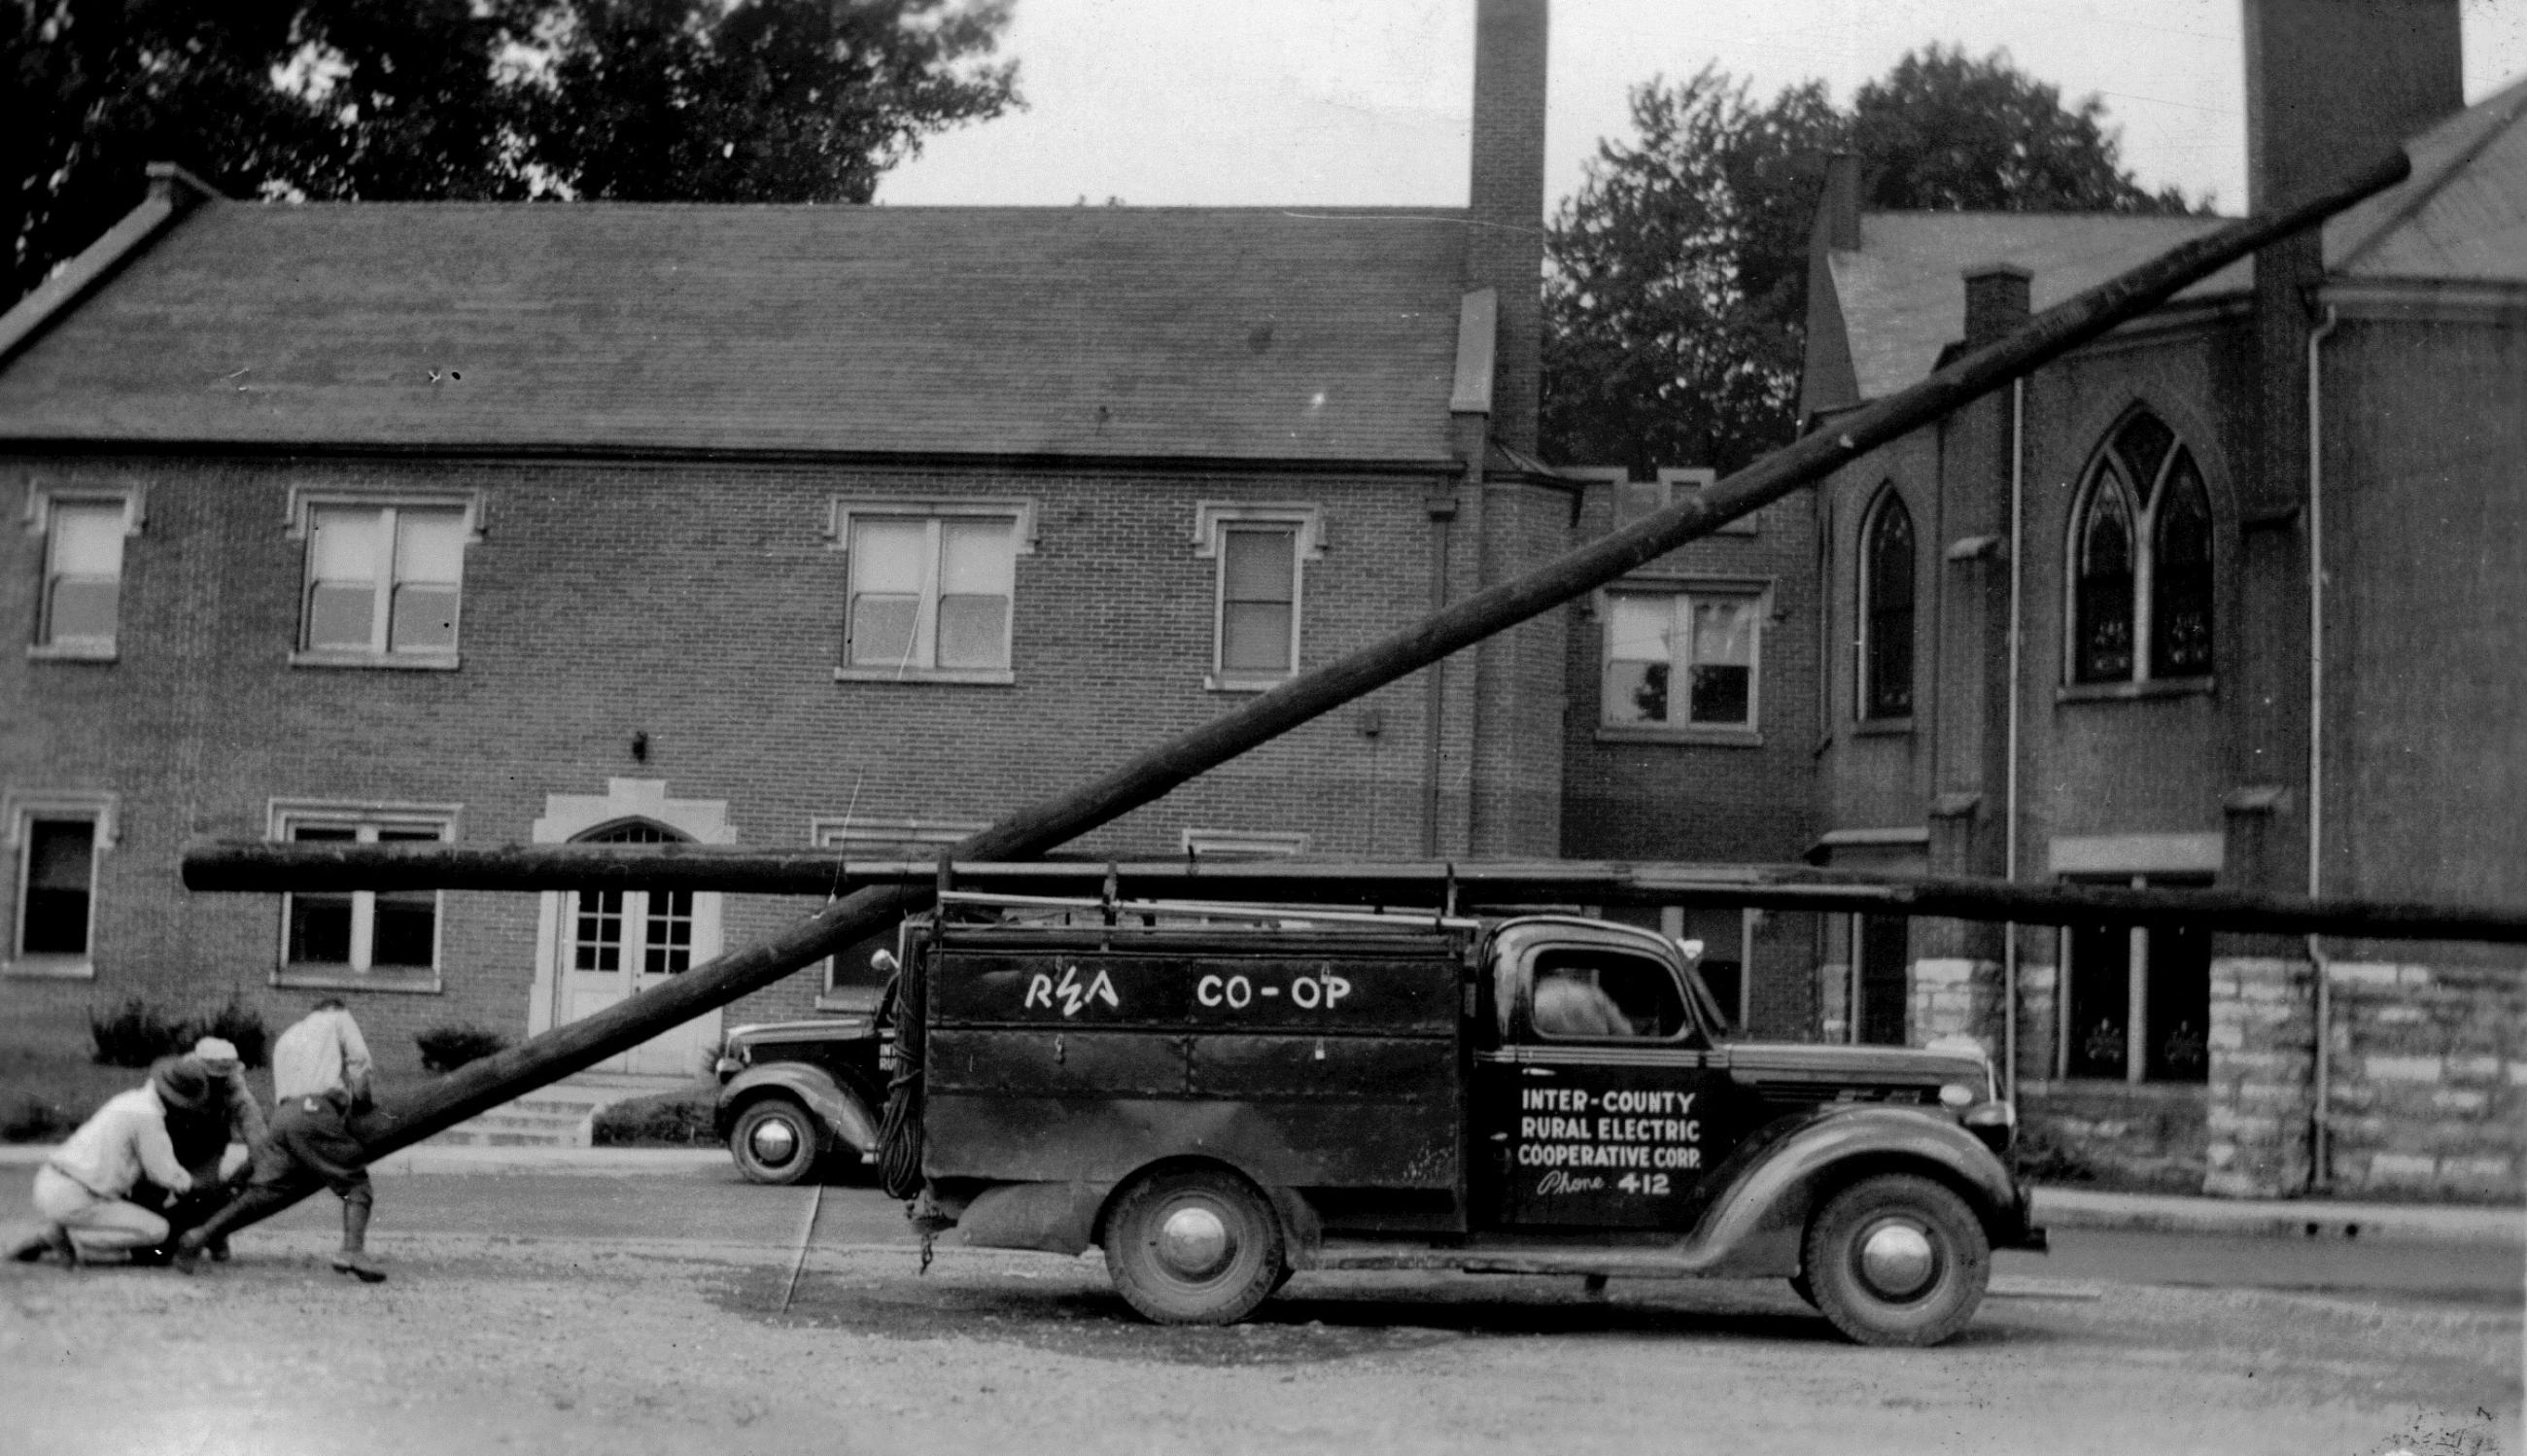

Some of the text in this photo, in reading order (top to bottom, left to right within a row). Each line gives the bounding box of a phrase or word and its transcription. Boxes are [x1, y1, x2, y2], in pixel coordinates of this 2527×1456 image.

[1196, 975, 1351, 1009] CO-OP
[1522, 1089, 1696, 1114] INTER-COUNTY
[1521, 1117, 1700, 1142] RURAL ELECTRIC
[1518, 1144, 1650, 1166] COOPERATIVE
[1537, 1169, 1670, 1196] Phone 412
